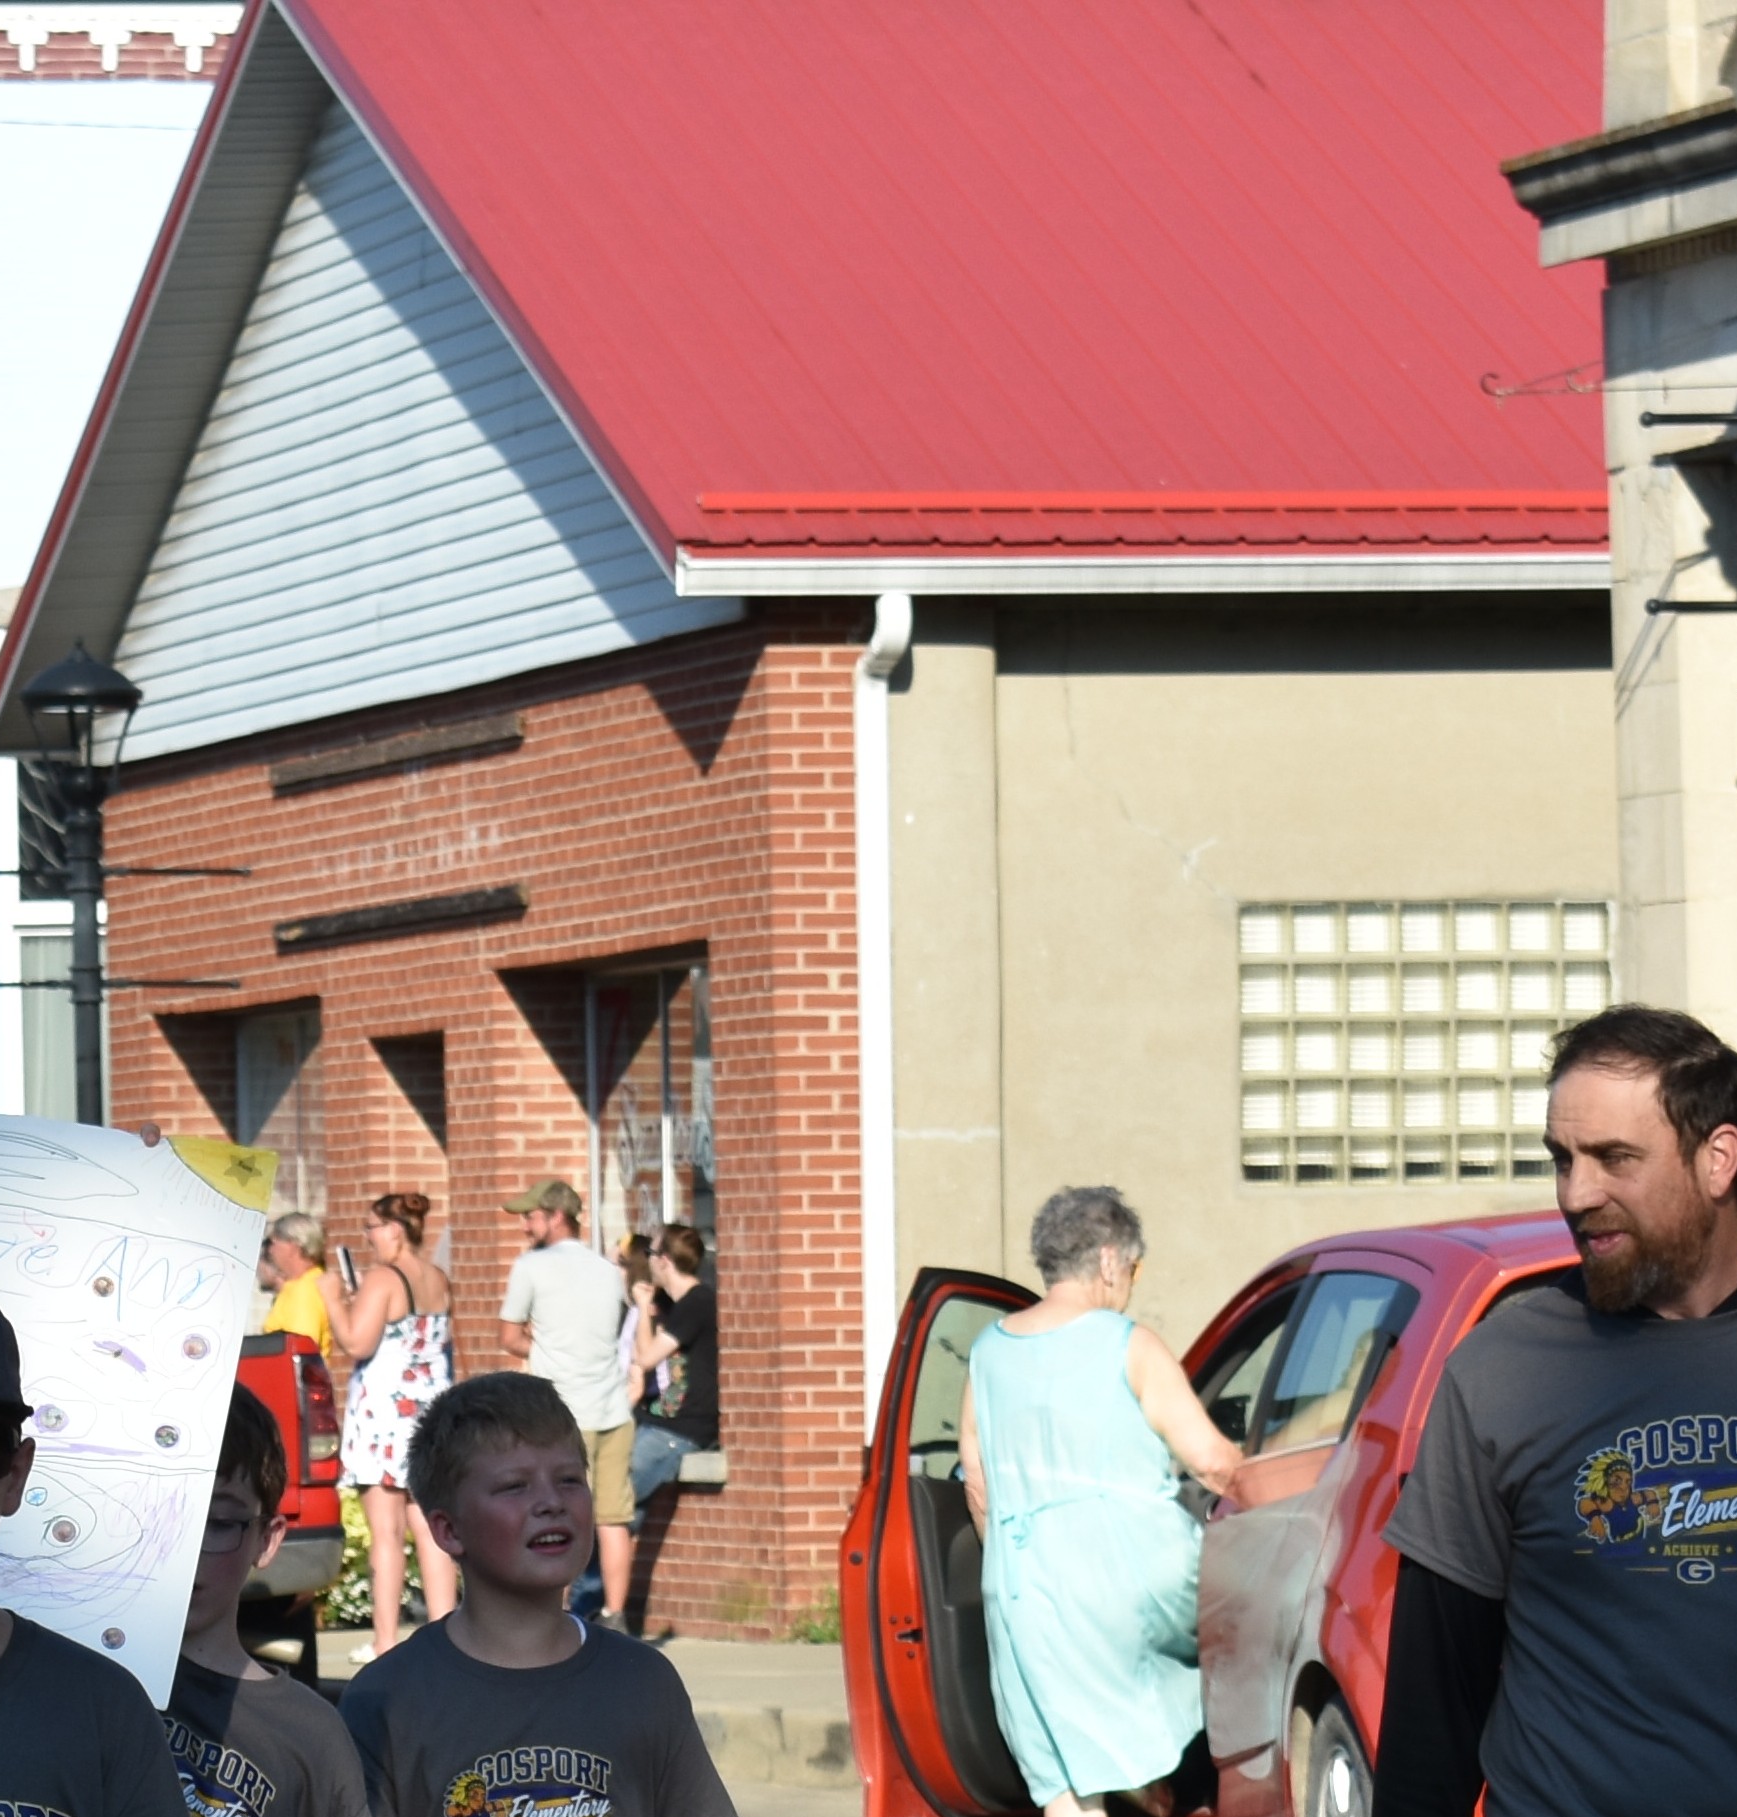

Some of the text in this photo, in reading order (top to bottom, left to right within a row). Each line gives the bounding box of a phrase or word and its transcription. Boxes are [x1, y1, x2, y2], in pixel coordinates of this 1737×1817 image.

[1663, 1545, 1719, 1556] ACHIEVE
[1677, 1558, 1714, 1584] G
[475, 1746, 611, 1794] GOSPORT
